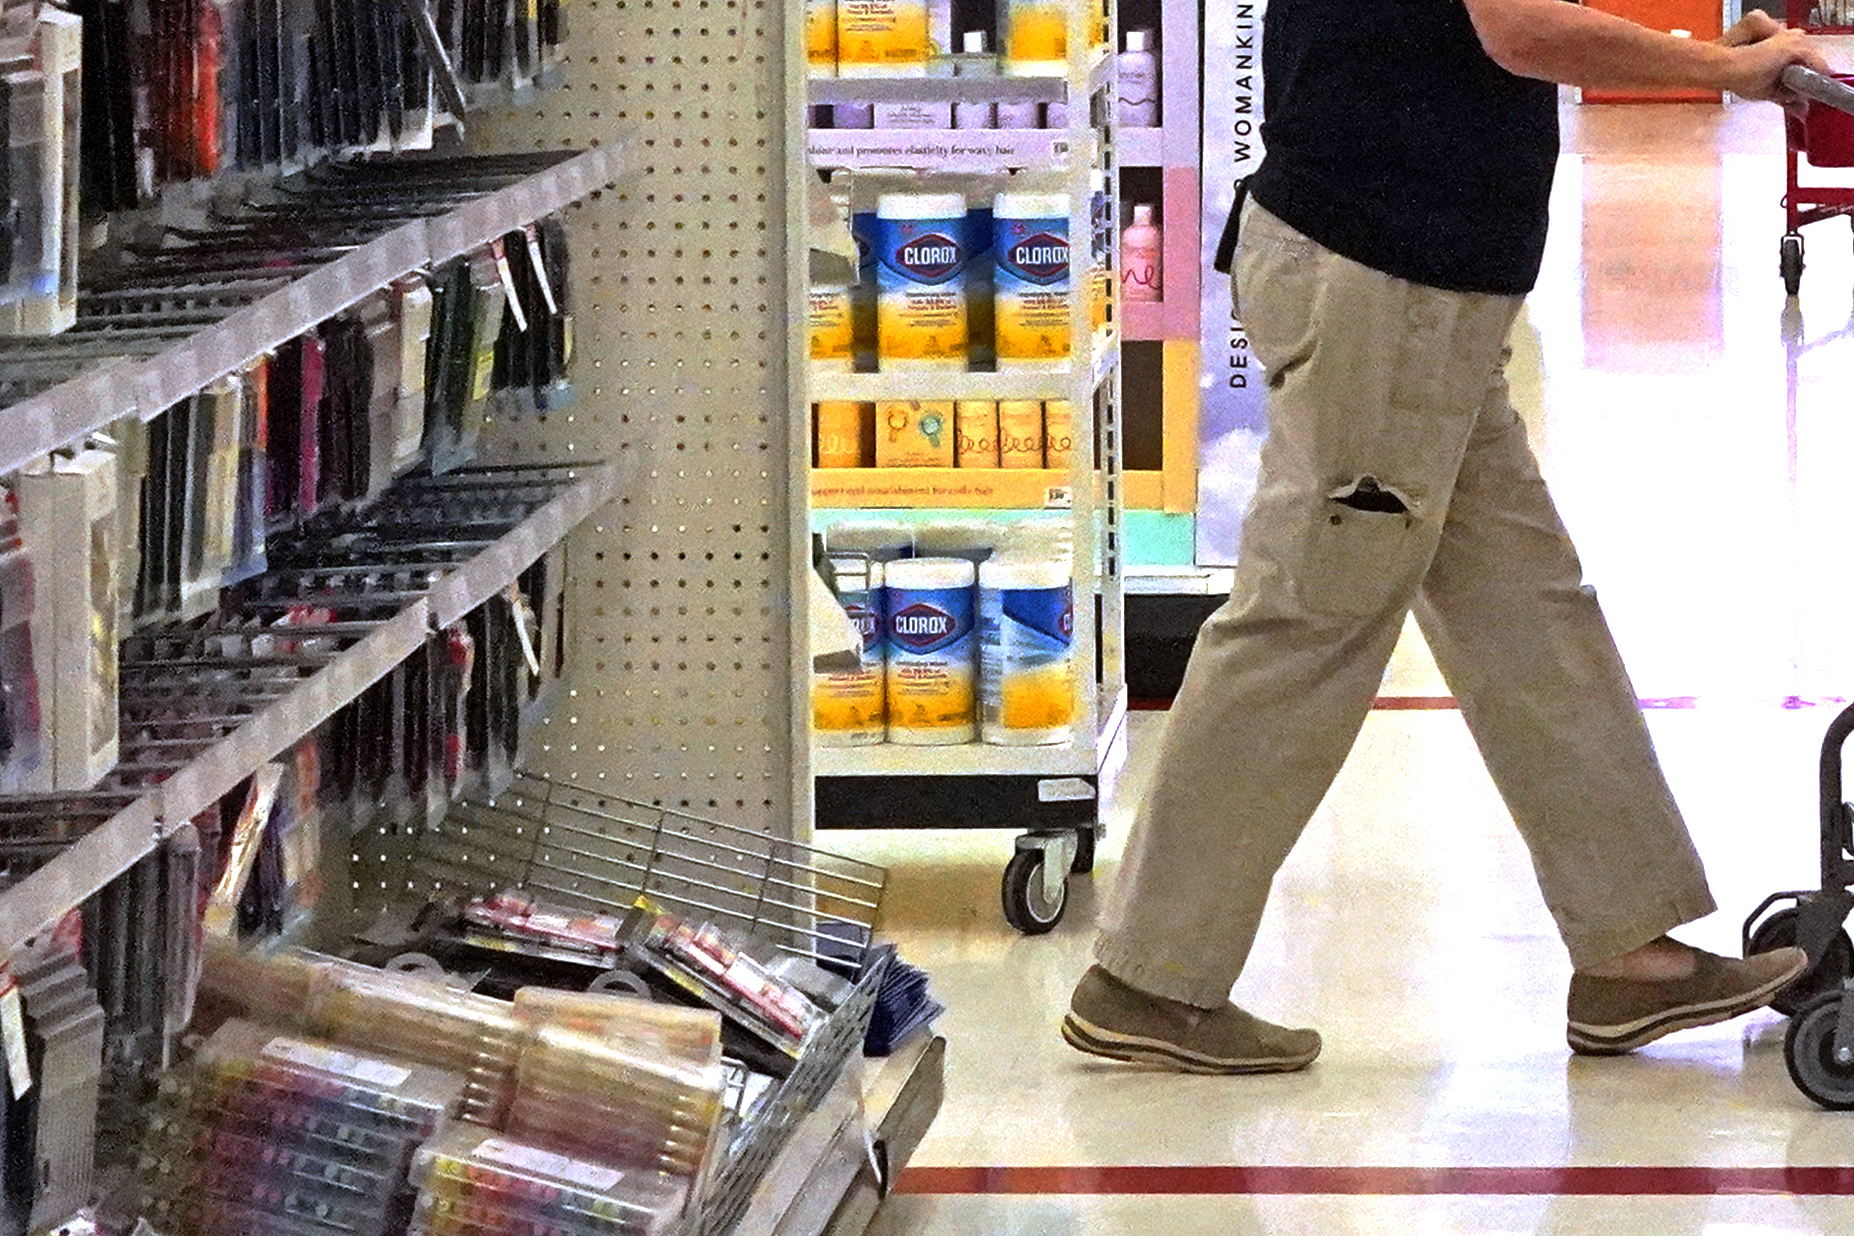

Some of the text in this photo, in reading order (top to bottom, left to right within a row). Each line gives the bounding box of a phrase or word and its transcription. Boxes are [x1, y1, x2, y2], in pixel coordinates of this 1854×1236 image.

[904, 246, 957, 265] CLOROX
[1015, 246, 1069, 265] CLOROX
[1229, 309, 1251, 389] DESI
[895, 616, 948, 634] CLOROX
